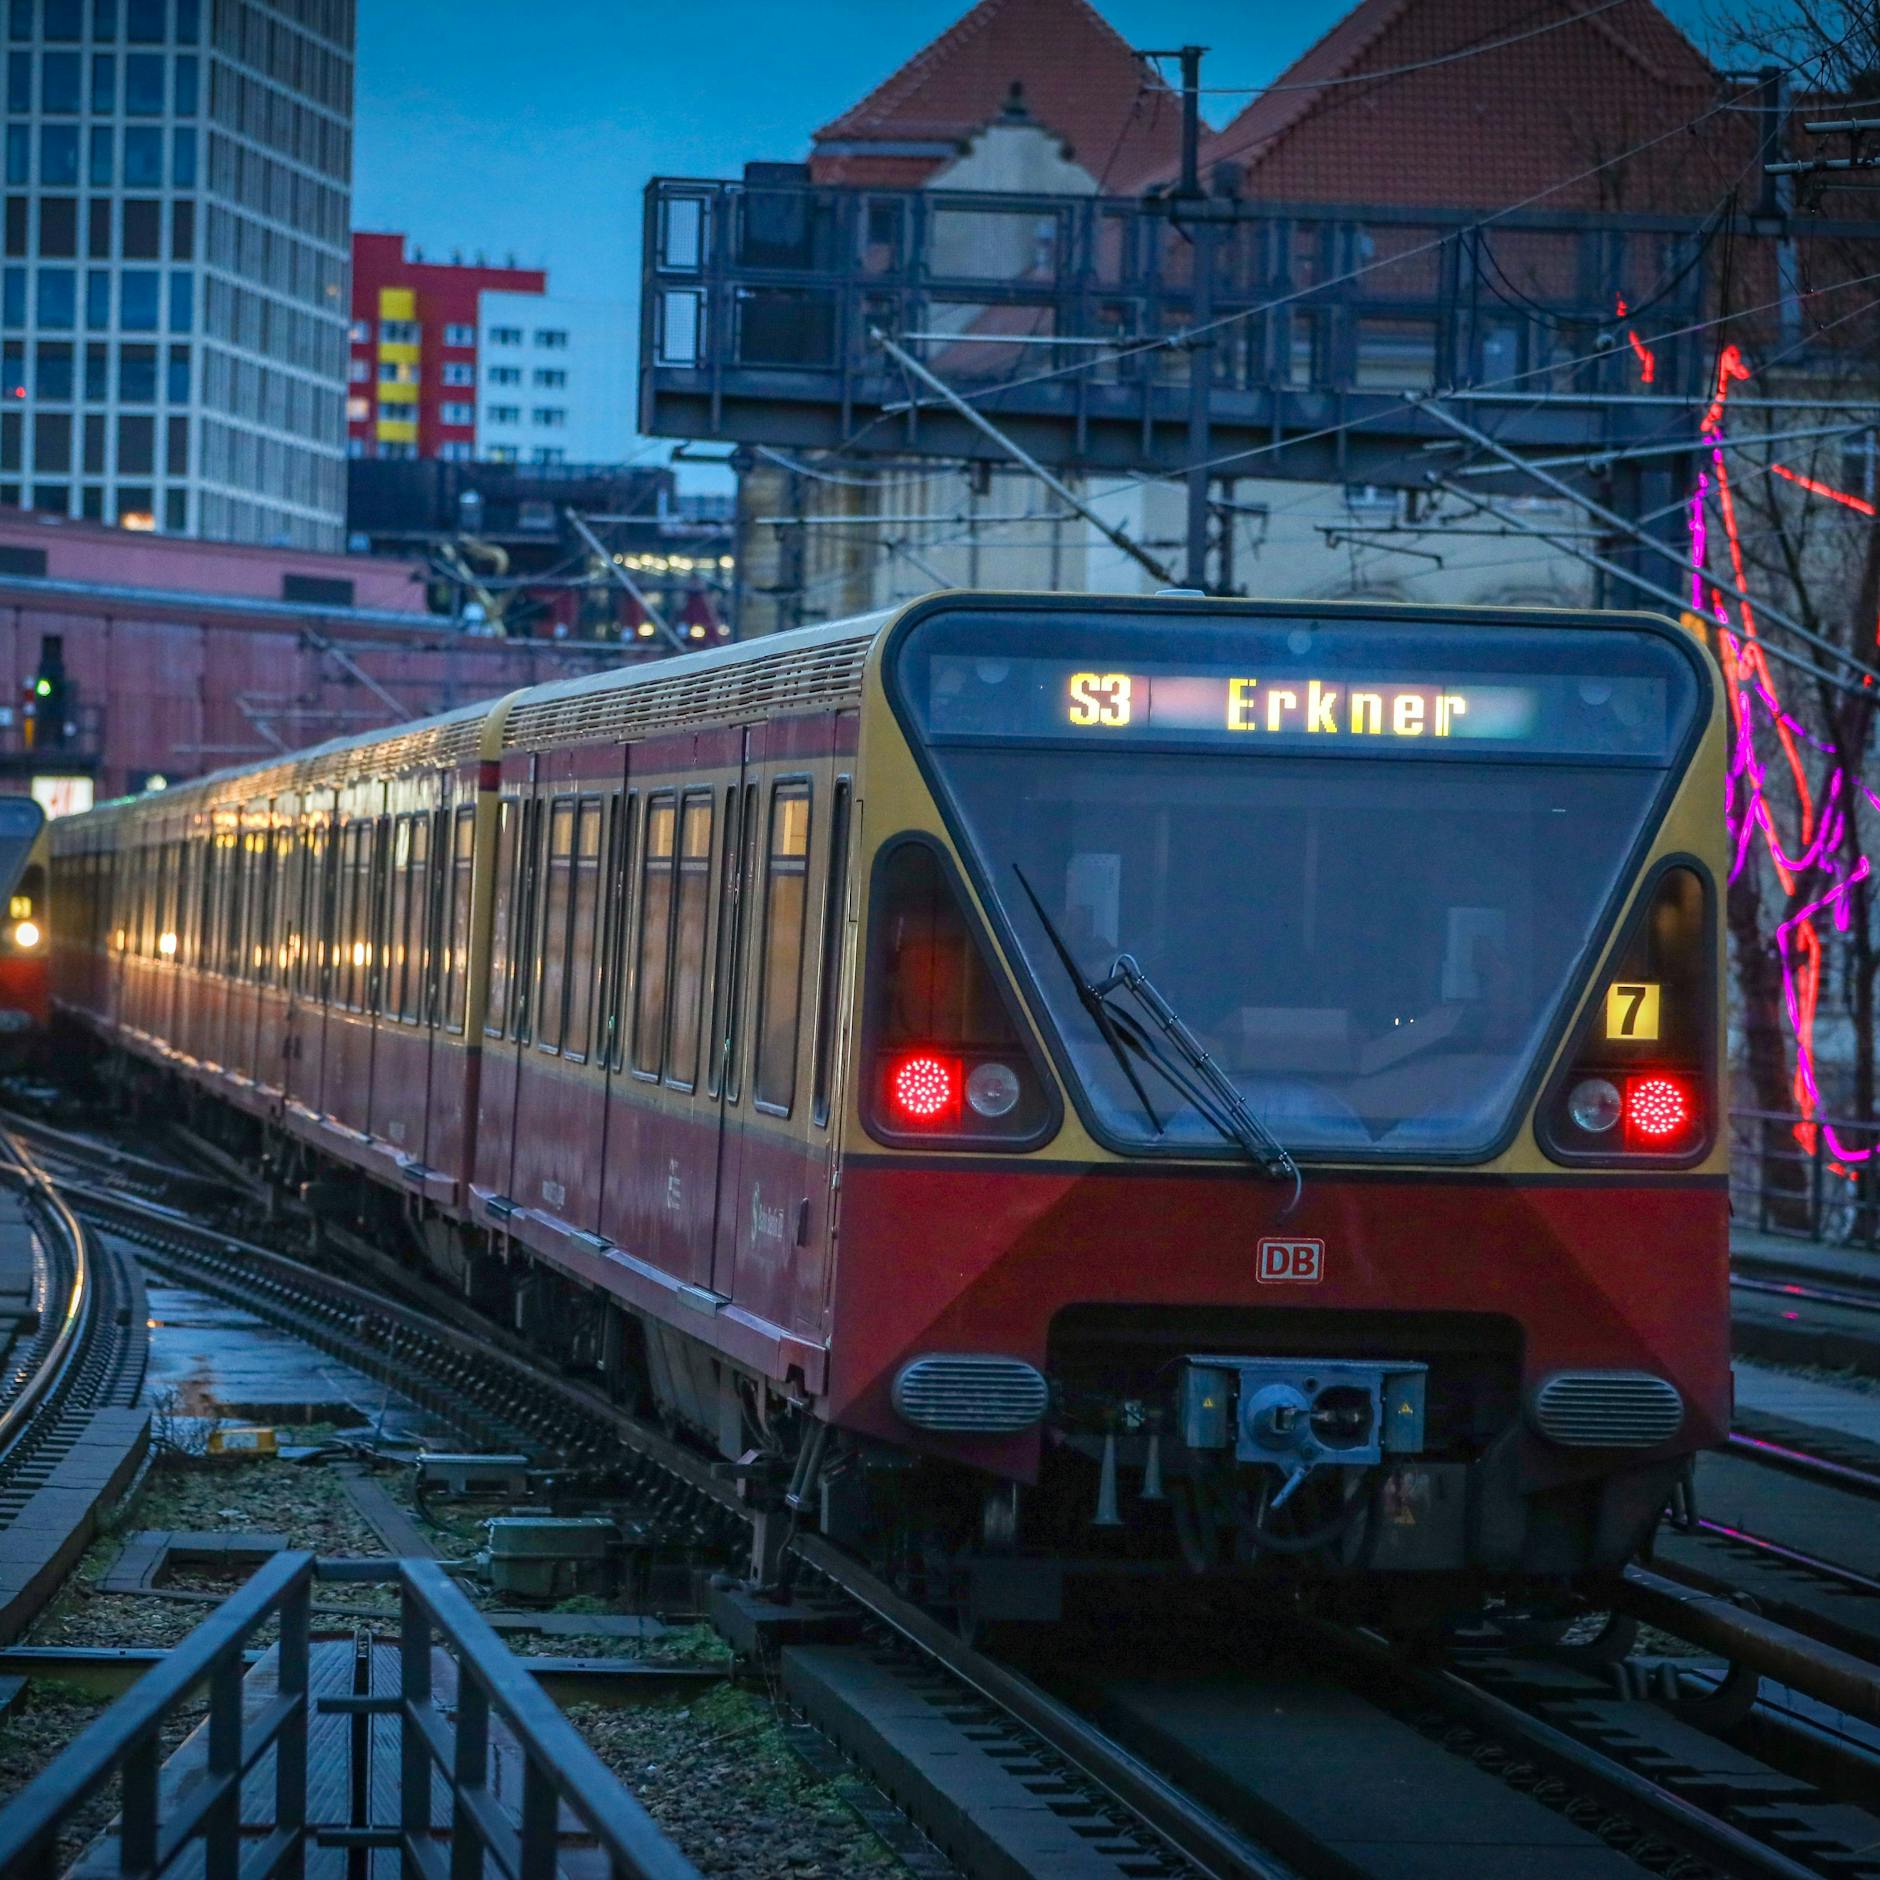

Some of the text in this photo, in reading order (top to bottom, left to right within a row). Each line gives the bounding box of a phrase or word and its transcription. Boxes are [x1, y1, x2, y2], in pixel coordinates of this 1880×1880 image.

[1068, 673, 1467, 737] S3 Erkner
[1616, 986, 1647, 1036] 7
[1263, 1244, 1318, 1278] DB
